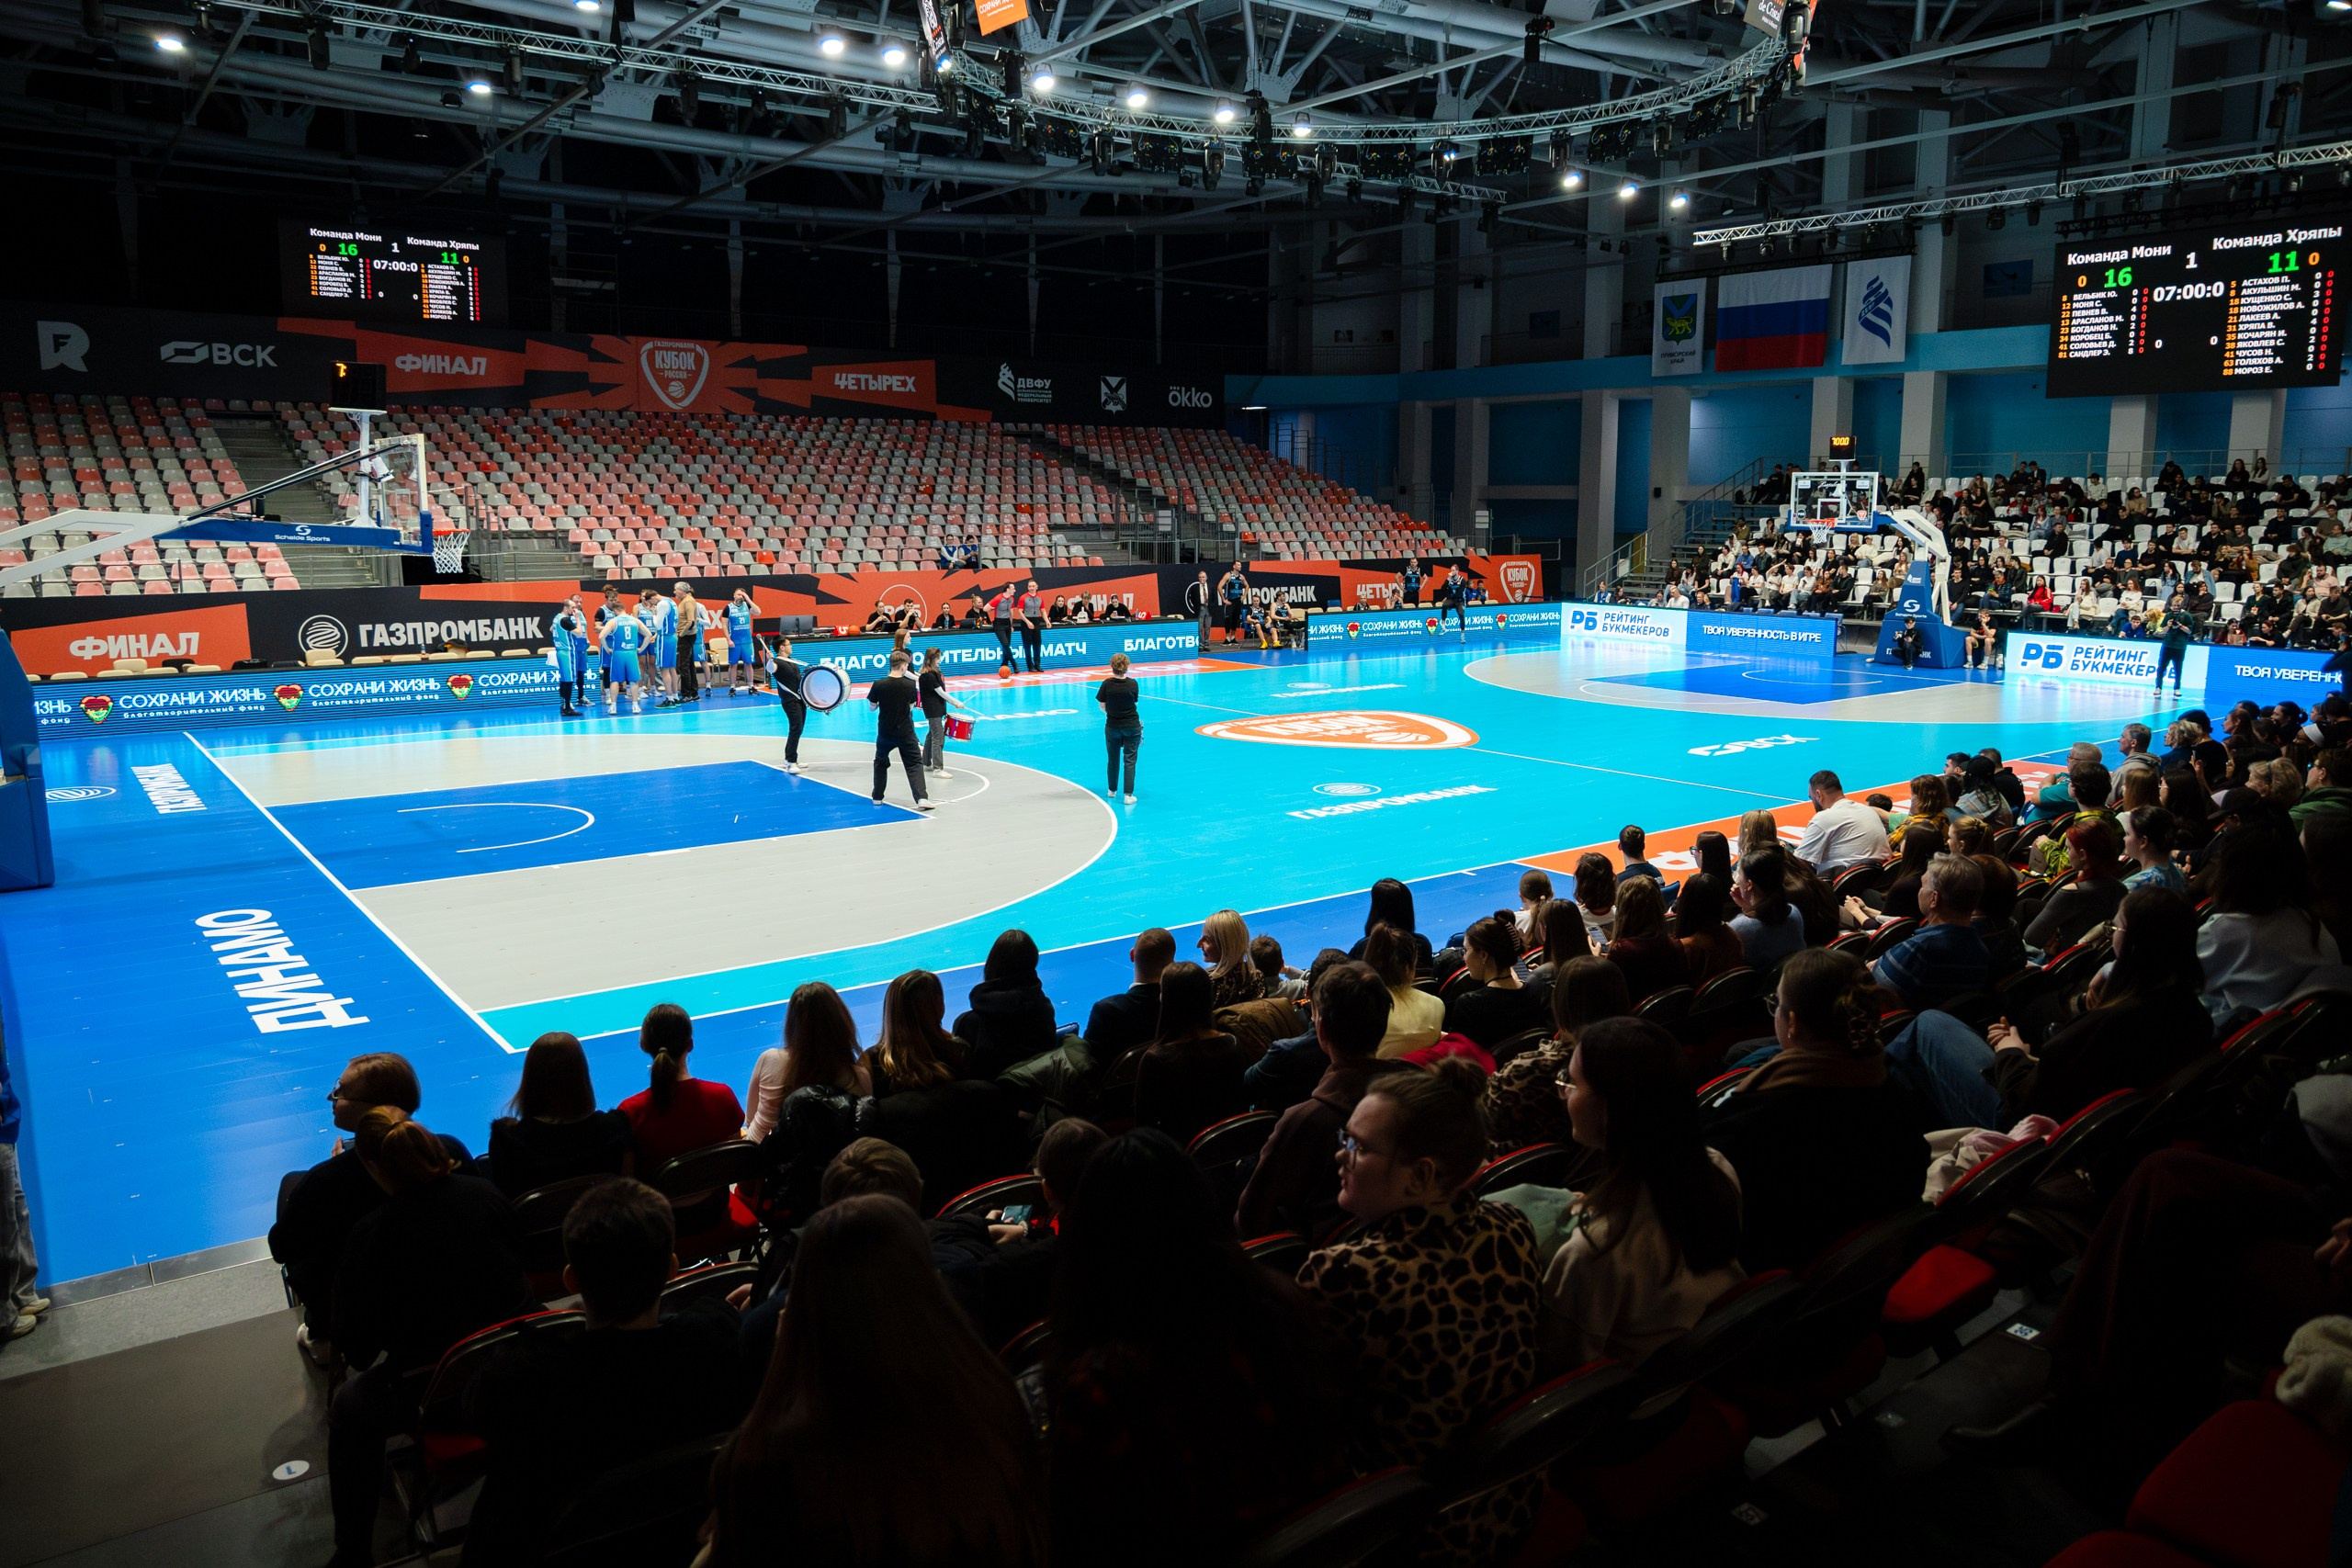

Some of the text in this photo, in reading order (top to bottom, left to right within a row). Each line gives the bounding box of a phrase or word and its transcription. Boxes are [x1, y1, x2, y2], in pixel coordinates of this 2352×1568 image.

[310, 229, 382, 242] Команда Мони
[2212, 226, 2342, 250] Команда Хряпы
[338, 243, 358, 255] 16
[391, 243, 400, 253] 1
[407, 237, 480, 251] Команда Хряпы
[441, 252, 459, 265] 11
[2068, 244, 2172, 266] Команда Мони
[2186, 253, 2198, 269] 1
[373, 260, 418, 272] 07:00:0
[2267, 252, 2320, 273] 11 0
[2077, 266, 2132, 288] 0 16
[2230, 280, 2237, 288] 5
[2241, 276, 2280, 287] АСТАХОВ
[2154, 281, 2224, 302] 07:00:0
[2240, 284, 2290, 296] АКУЛЬШИН
[2290, 283, 2301, 291] М.
[2062, 294, 2068, 302] 8
[2073, 291, 2107, 301] ВЕЛЬБИК
[2229, 290, 2320, 306] 18 КУЩЕНКО С. 3
[2062, 299, 2103, 310] 12 МОНЯ С.
[2239, 301, 2295, 313] НОВОЖИЛОВ
[2295, 301, 2305, 310] А.
[2061, 310, 2071, 319] 22
[2072, 308, 2100, 318] ПЕВНЕВ
[2131, 305, 2137, 313] 4
[2227, 315, 2238, 323] 21
[2238, 312, 2271, 322] ЛАКЕЕВ
[2061, 314, 2124, 327] 13 АРАСЛАНОВ М.
[2226, 324, 2237, 333] 31
[2237, 321, 2267, 332] ХРЯПА
[2070, 323, 2109, 333] БОГДАНОВ
[2237, 330, 2277, 340] КОЧАРЯН
[2277, 329, 2288, 337] И.
[2070, 333, 2104, 342] КОРОБЕЦ
[2104, 332, 2112, 340] Б.
[2210, 336, 2218, 345] 0
[2224, 335, 2315, 350] 38 ЯКОВЛЕВ С. 2
[2069, 341, 2108, 350] СОЛОВЬЕВ
[2108, 340, 2117, 348] Д.
[2154, 339, 2163, 349] 0
[211, 343, 277, 367] ВСК
[1660, 350, 1696, 358] ПРИМОРСКИЙ
[2058, 351, 2068, 359] 81
[2068, 349, 2103, 358] САНДЛЕР
[2102, 348, 2111, 356] Э.
[2235, 348, 2264, 357] ЧУСОВ
[395, 354, 487, 375] ФИНАЛ
[654, 350, 695, 370] КУБОК
[2222, 359, 2234, 367] 63
[2234, 356, 2274, 367] ГОЛЯХОВ
[2307, 354, 2314, 362] 2
[664, 370, 687, 378] РОССИИ
[2233, 366, 2264, 375] МОРОЗ
[2264, 366, 2273, 374] Е.
[834, 373, 916, 392] ЧЕТЫРЕХ
[1017, 378, 1052, 389] ДВФУ
[1507, 568, 1529, 581] КУБОК
[1472, 615, 1494, 624] ЖИЗНЬ
[1509, 612, 1561, 622] СОХРАНИ ЖИЗНЬ
[1570, 610, 1598, 631] РБ
[1604, 612, 1650, 625] РЕЙТИНГ
[359, 616, 544, 648] ГАЗПРОМБАНК
[1319, 625, 1343, 634] ЖИЗНЬ
[1363, 620, 1423, 631] СОХРАНИ ЖИЗНЬ
[1602, 623, 1669, 637] БУКМЕКЕРОВ
[625, 626, 631, 640] 8
[1702, 625, 1821, 643] ТВОЯ УВЕРЕННОСТЬ В ИГРЕ
[69, 632, 199, 660] ФИНАЛ
[1040, 642, 1086, 657] МАТЧ
[2021, 643, 2063, 669] РБ
[2074, 646, 2148, 663] РЕЙТИНГ
[2234, 665, 2272, 678] ТВОЯ
[479, 671, 547, 687] СОХРАНИ
[309, 677, 440, 697] СОХРАНИ ЖИЗНЬ
[1270, 683, 1407, 698] ГАЗПРОМБАНК
[119, 687, 266, 709] СОХРАНИ ЖИЗНЬ
[312, 694, 412, 706] благотворительный
[123, 705, 265, 718] благотворительный фонд
[130, 763, 208, 815] ГАЗПРОМБАНК
[1285, 784, 1498, 819] ГАЗПРОМБАНК
[195, 909, 370, 1033] ДИНАМО
